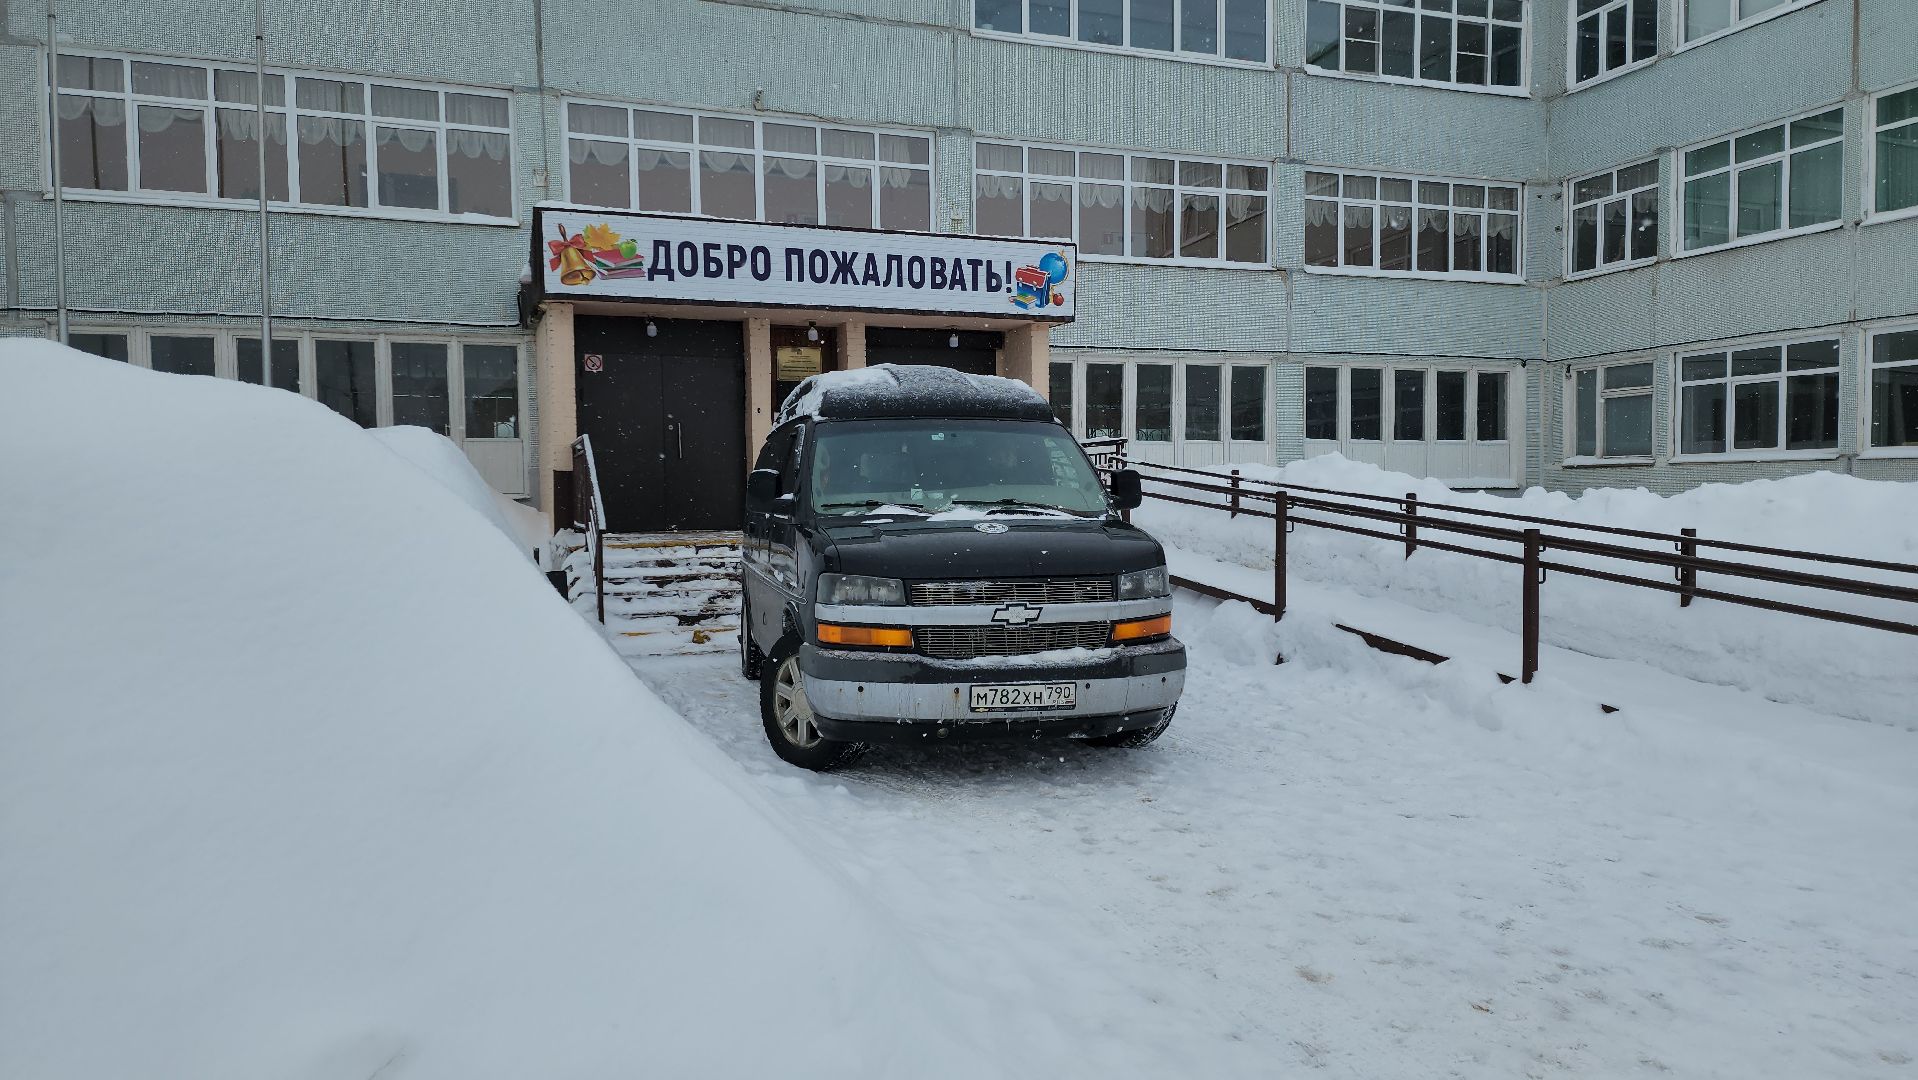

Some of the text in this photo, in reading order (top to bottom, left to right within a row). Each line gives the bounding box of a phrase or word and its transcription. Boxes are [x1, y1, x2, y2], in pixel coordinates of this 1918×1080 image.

[648, 240, 1013, 293] ДОБРО ПОЖАЛОВАТЬ!
[976, 687, 1070, 705] М782ХН 790
